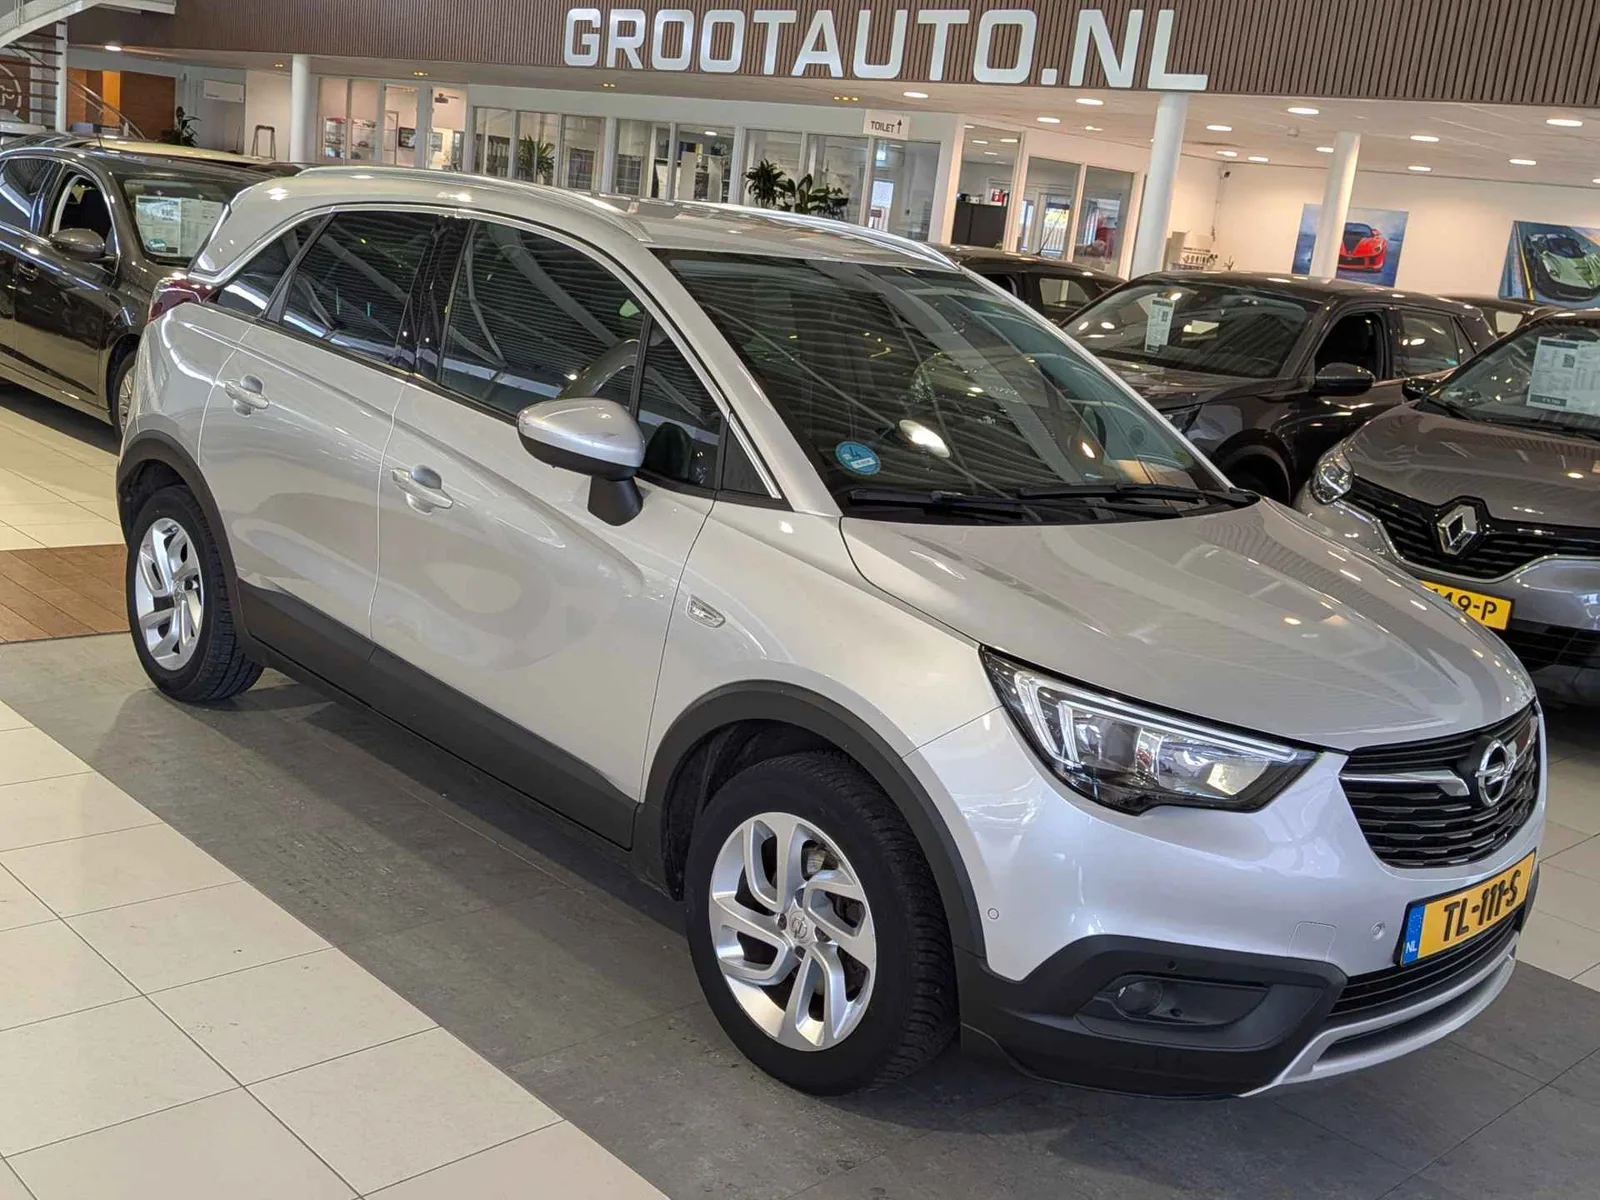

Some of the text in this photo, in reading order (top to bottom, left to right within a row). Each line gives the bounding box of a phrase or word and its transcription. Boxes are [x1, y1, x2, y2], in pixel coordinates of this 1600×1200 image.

[564, 8, 1208, 91] GROOTAUTO.NL
[870, 120, 896, 133] TOILET
[1432, 588, 1497, 621] 9-P
[1442, 869, 1521, 942] TL-111-S
[1405, 940, 1417, 954] NL
